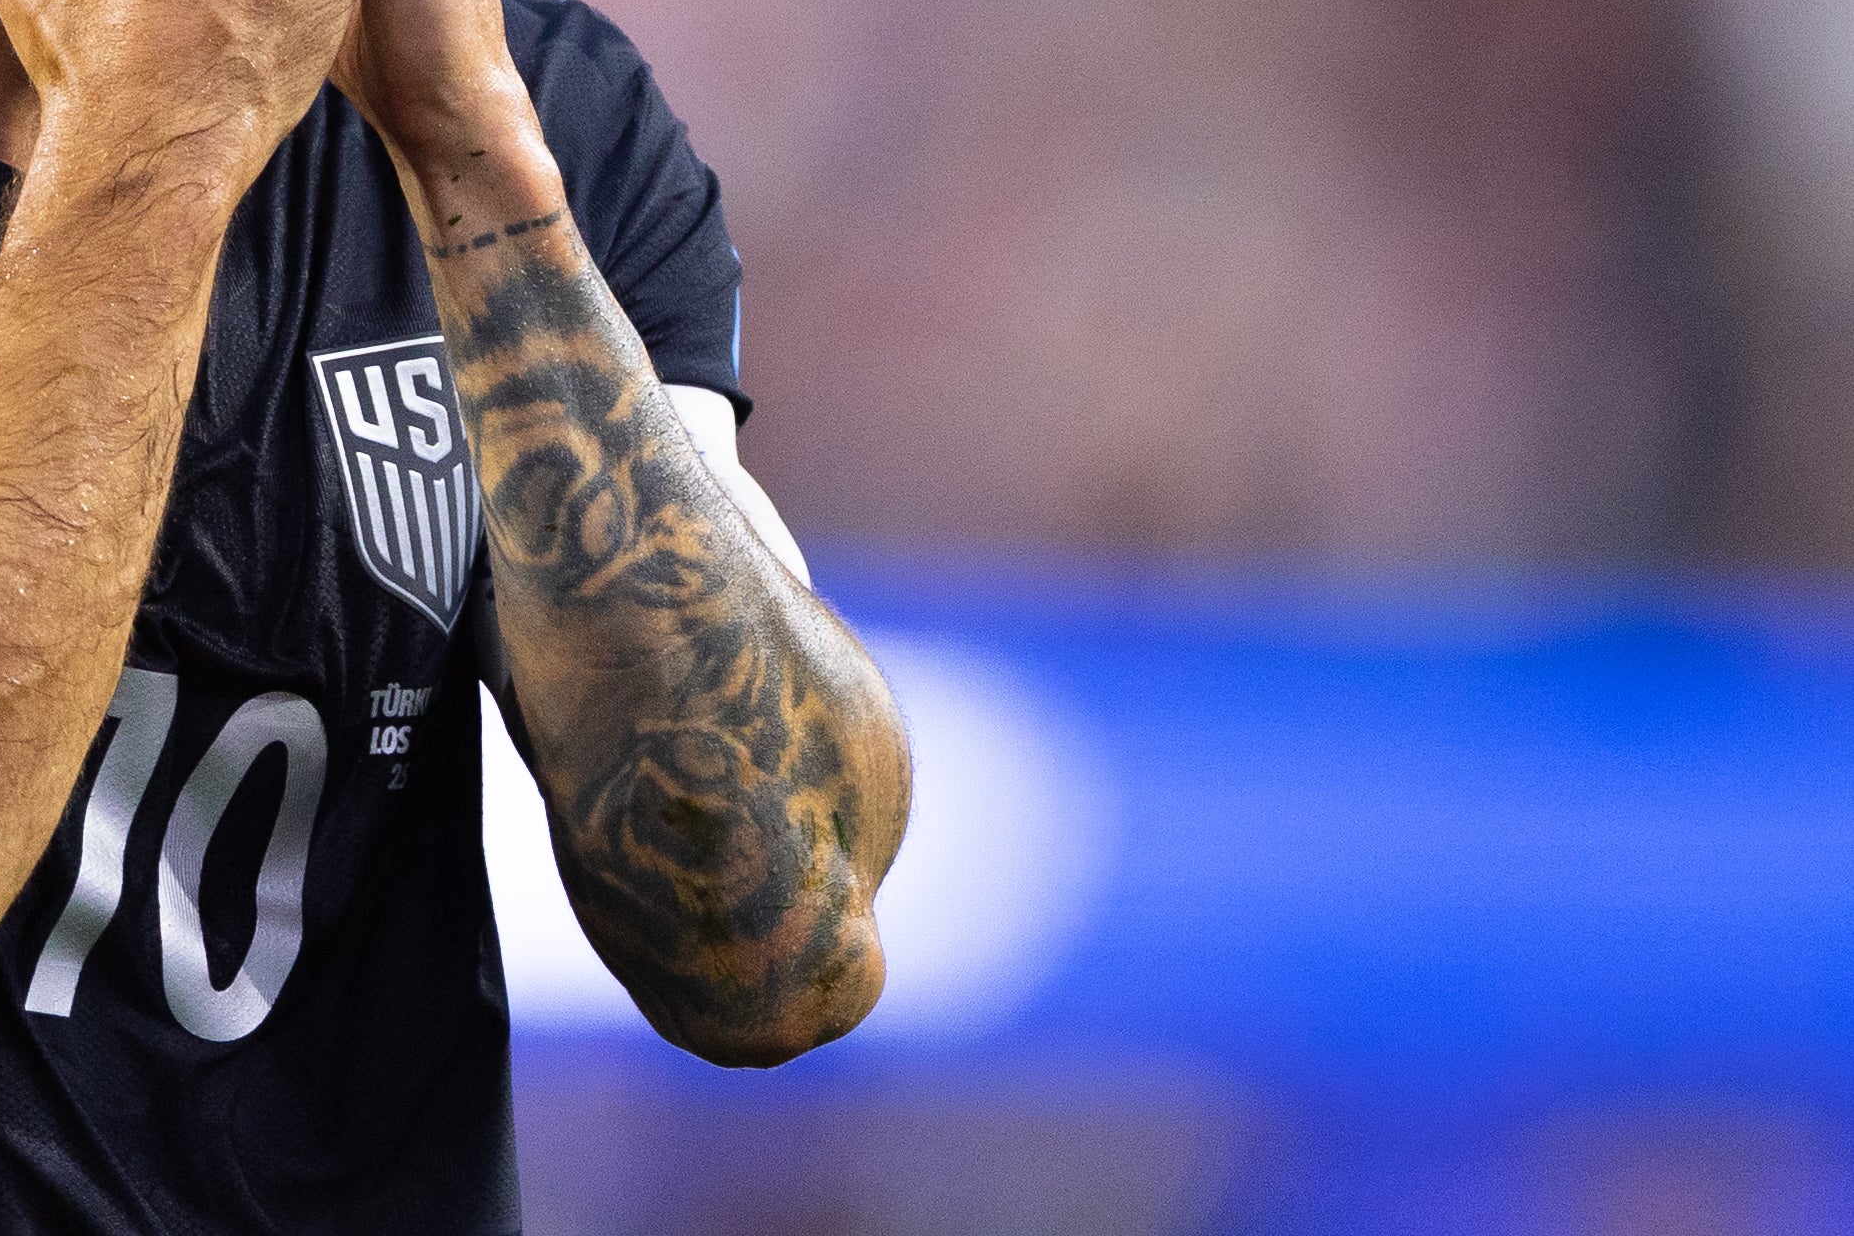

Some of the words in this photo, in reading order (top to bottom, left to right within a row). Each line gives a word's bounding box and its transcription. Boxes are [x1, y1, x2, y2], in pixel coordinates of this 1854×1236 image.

[335, 357, 467, 462] US
[370, 725, 412, 755] LOS
[25, 667, 328, 1042] 10
